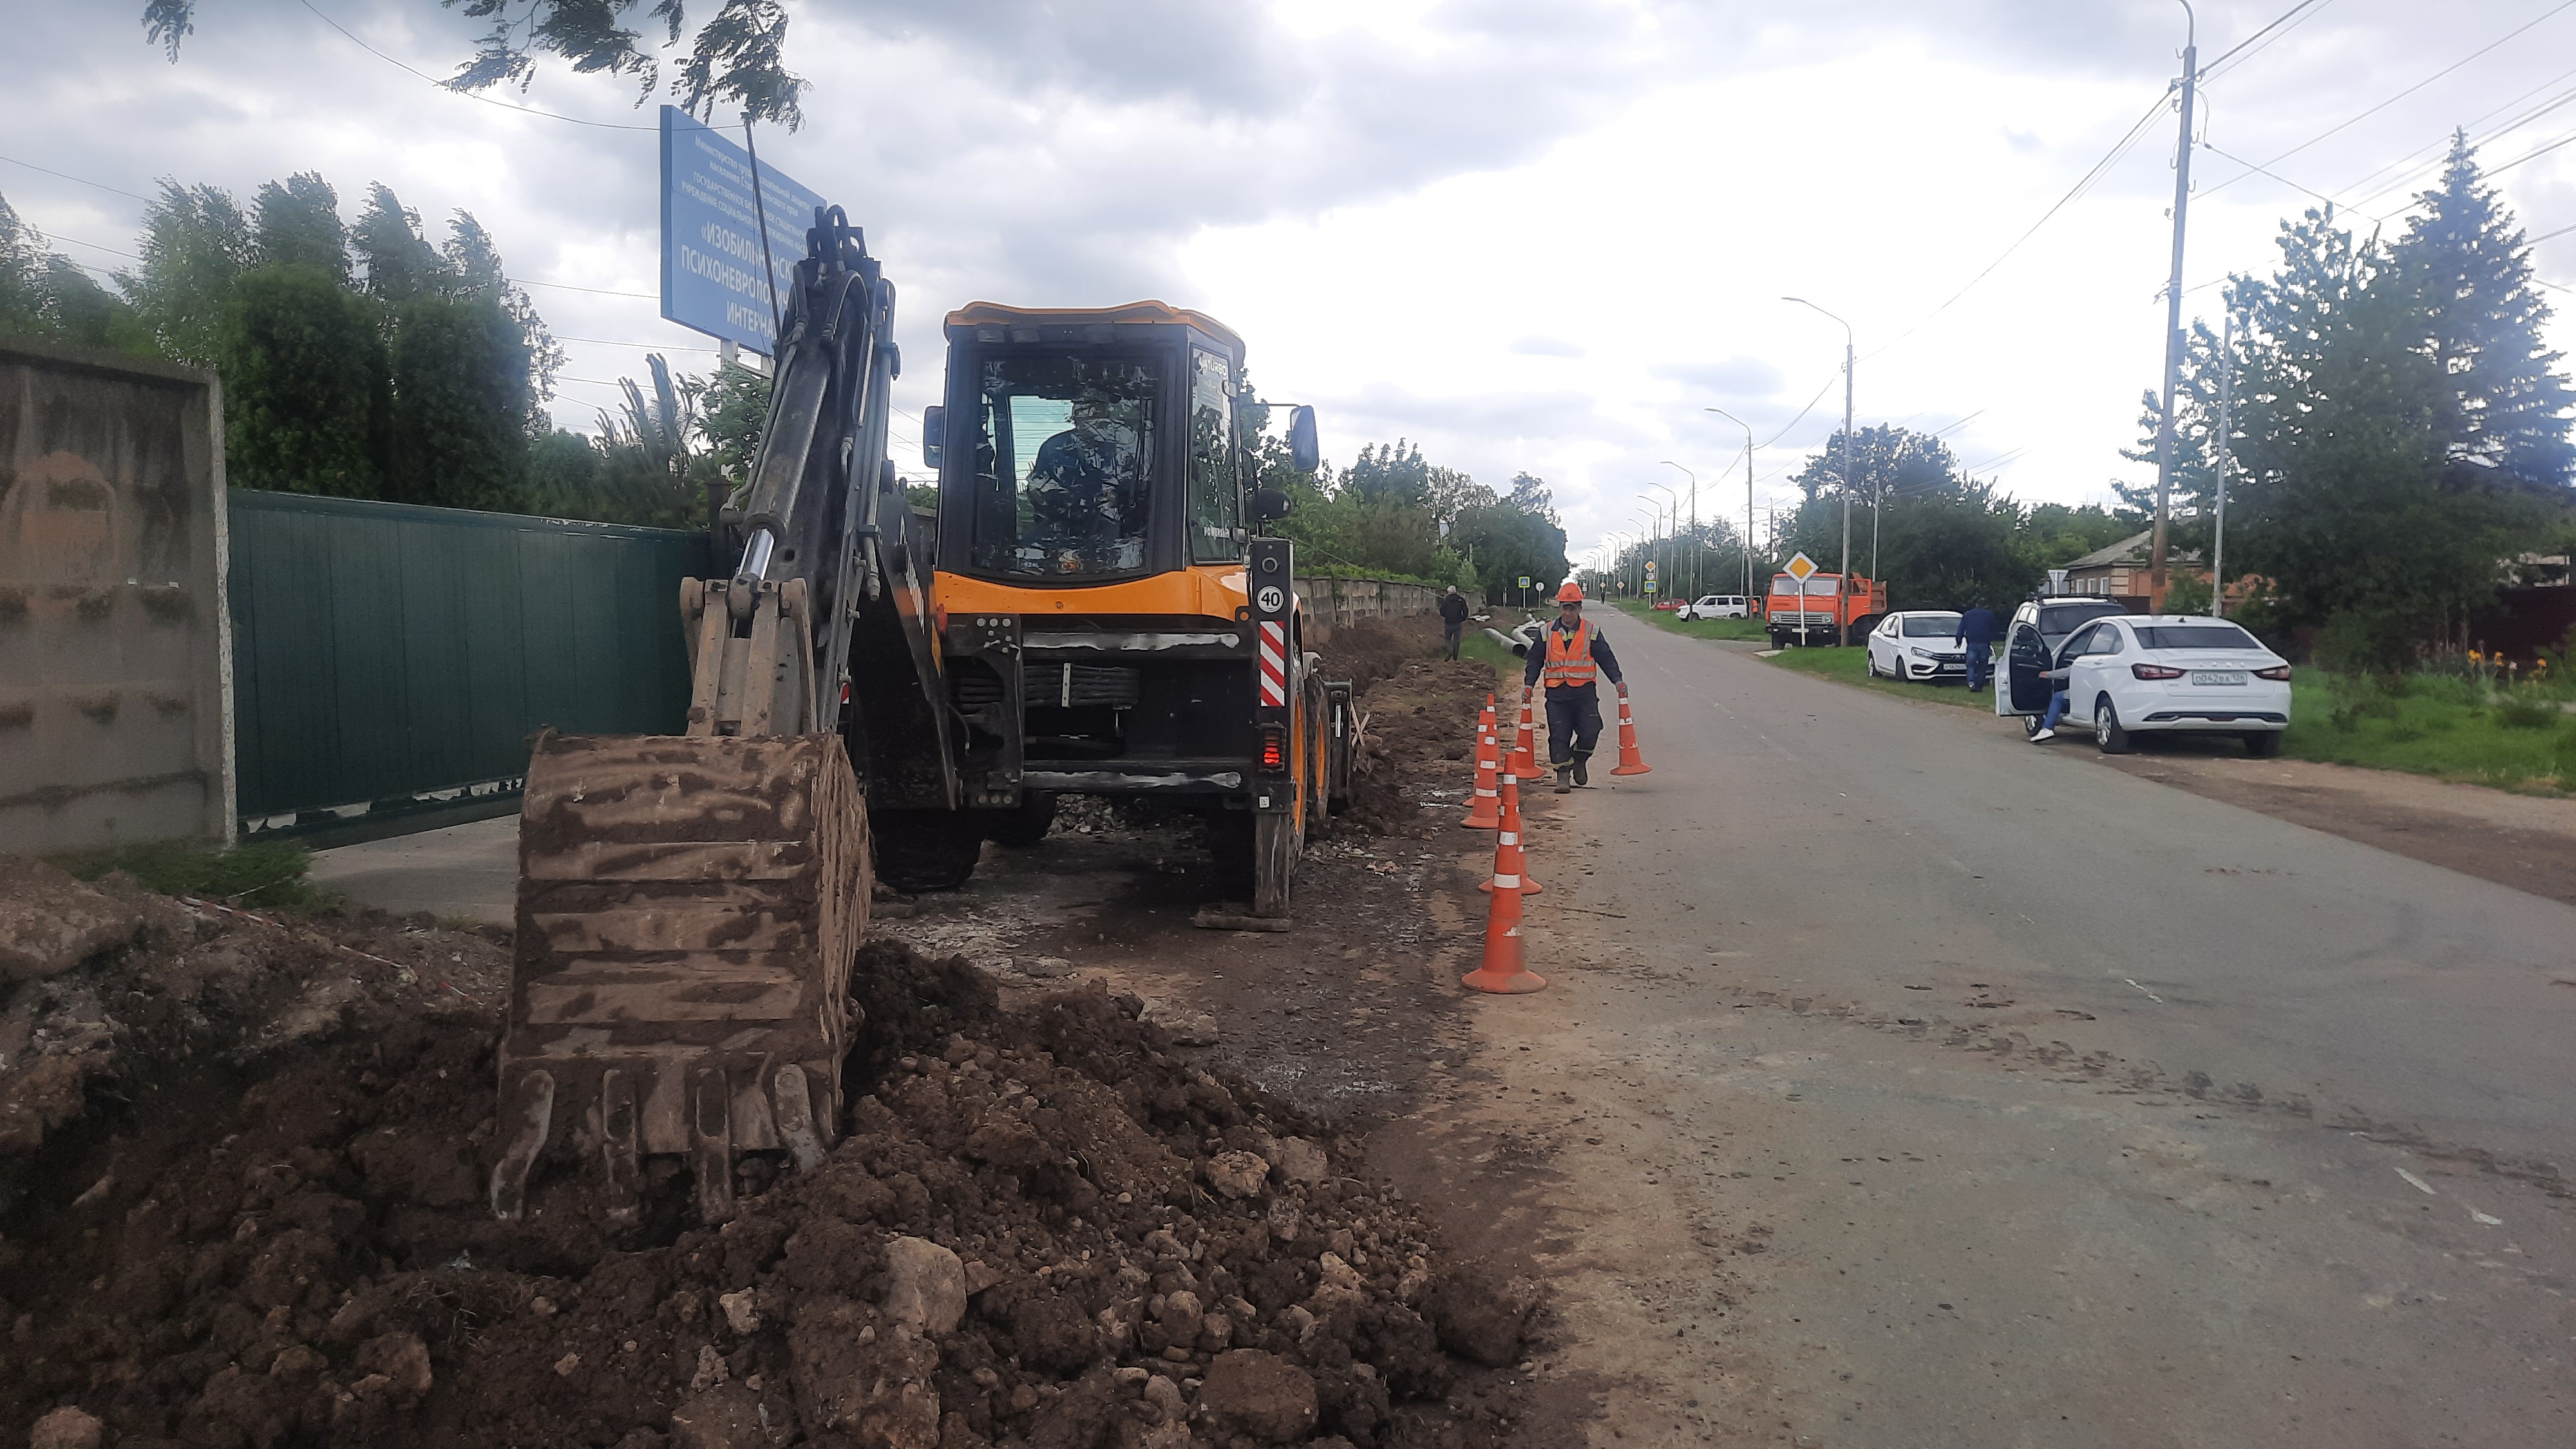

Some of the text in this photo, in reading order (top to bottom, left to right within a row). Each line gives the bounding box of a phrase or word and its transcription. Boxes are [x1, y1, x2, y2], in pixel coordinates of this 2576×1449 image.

[681, 244, 790, 310] ПСИХОНЕВРОЛОИЧ
[726, 300, 778, 340] ИНТЕРНА
[1261, 592, 1280, 607] 40
